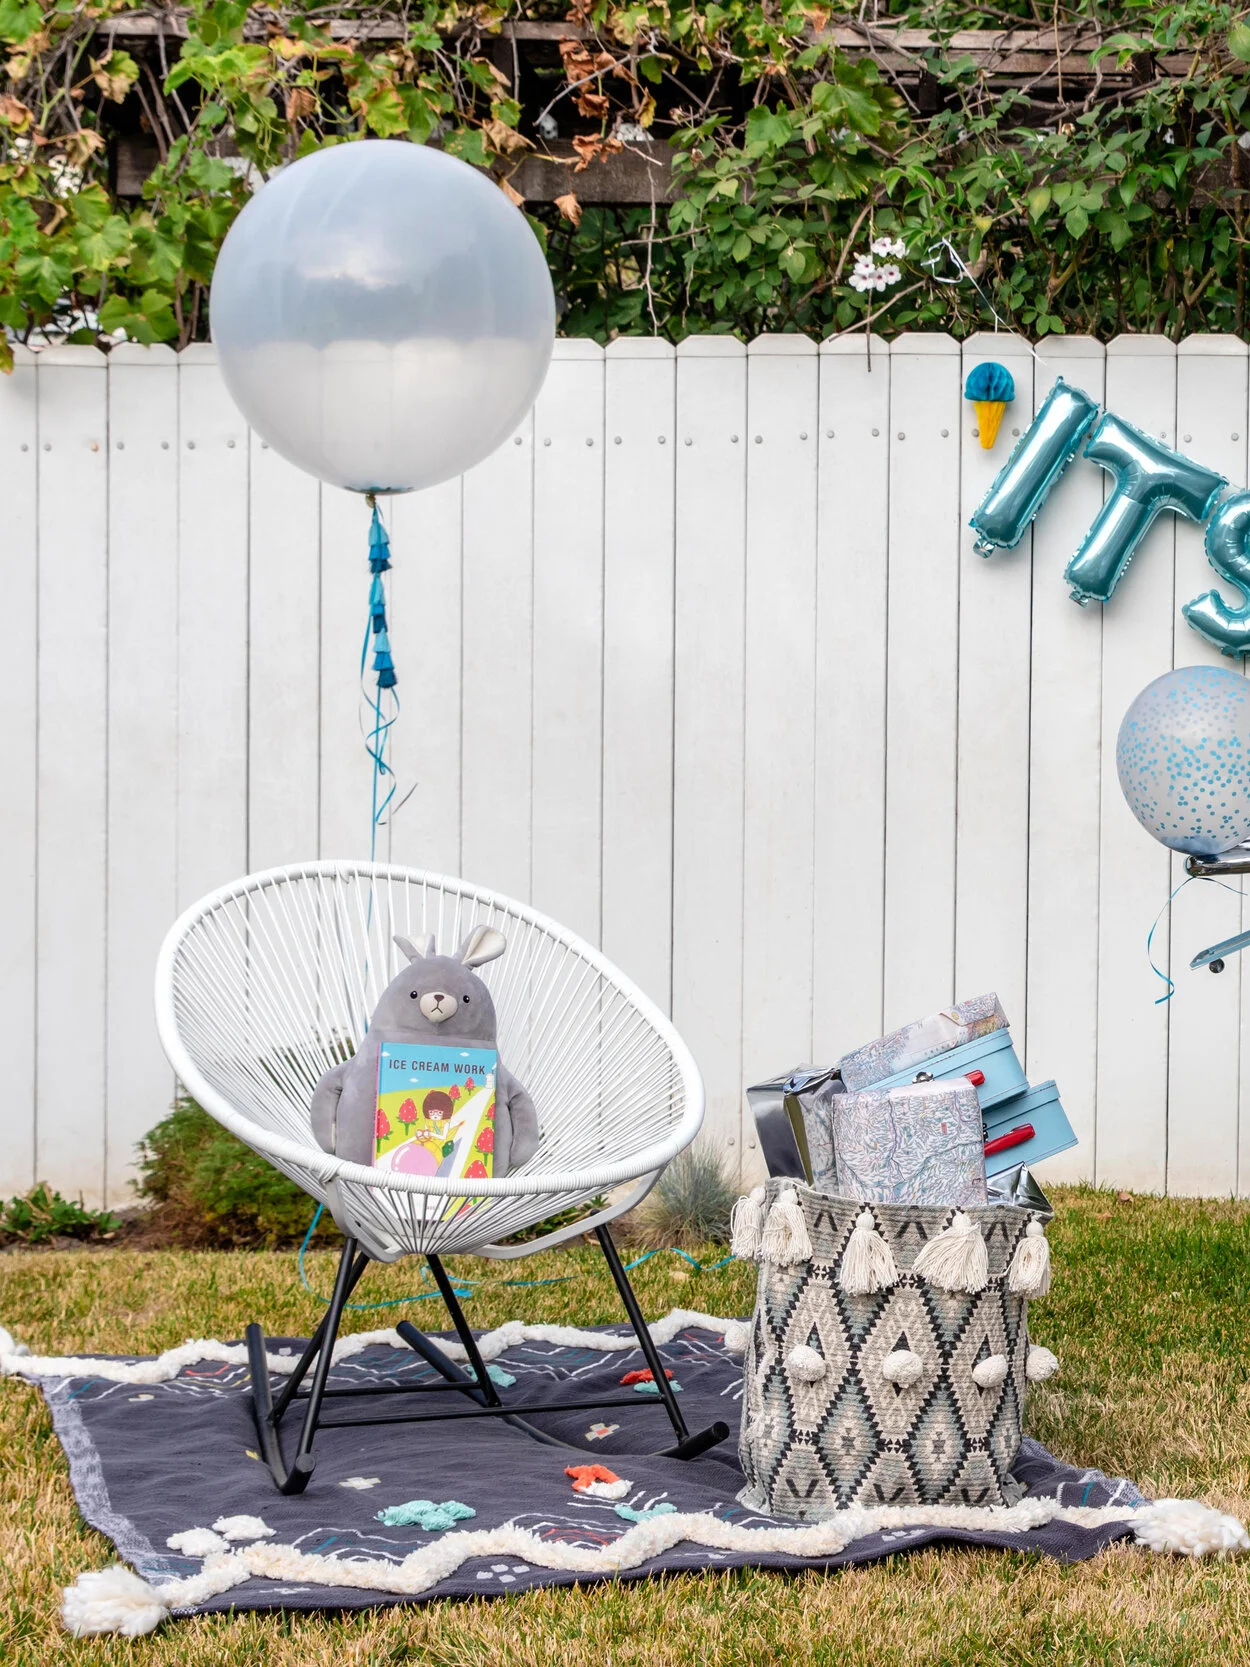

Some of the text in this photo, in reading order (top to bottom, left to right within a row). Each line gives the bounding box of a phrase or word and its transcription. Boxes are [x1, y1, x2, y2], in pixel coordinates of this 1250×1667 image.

[389, 1059, 485, 1075] ICE CREAM WORK
